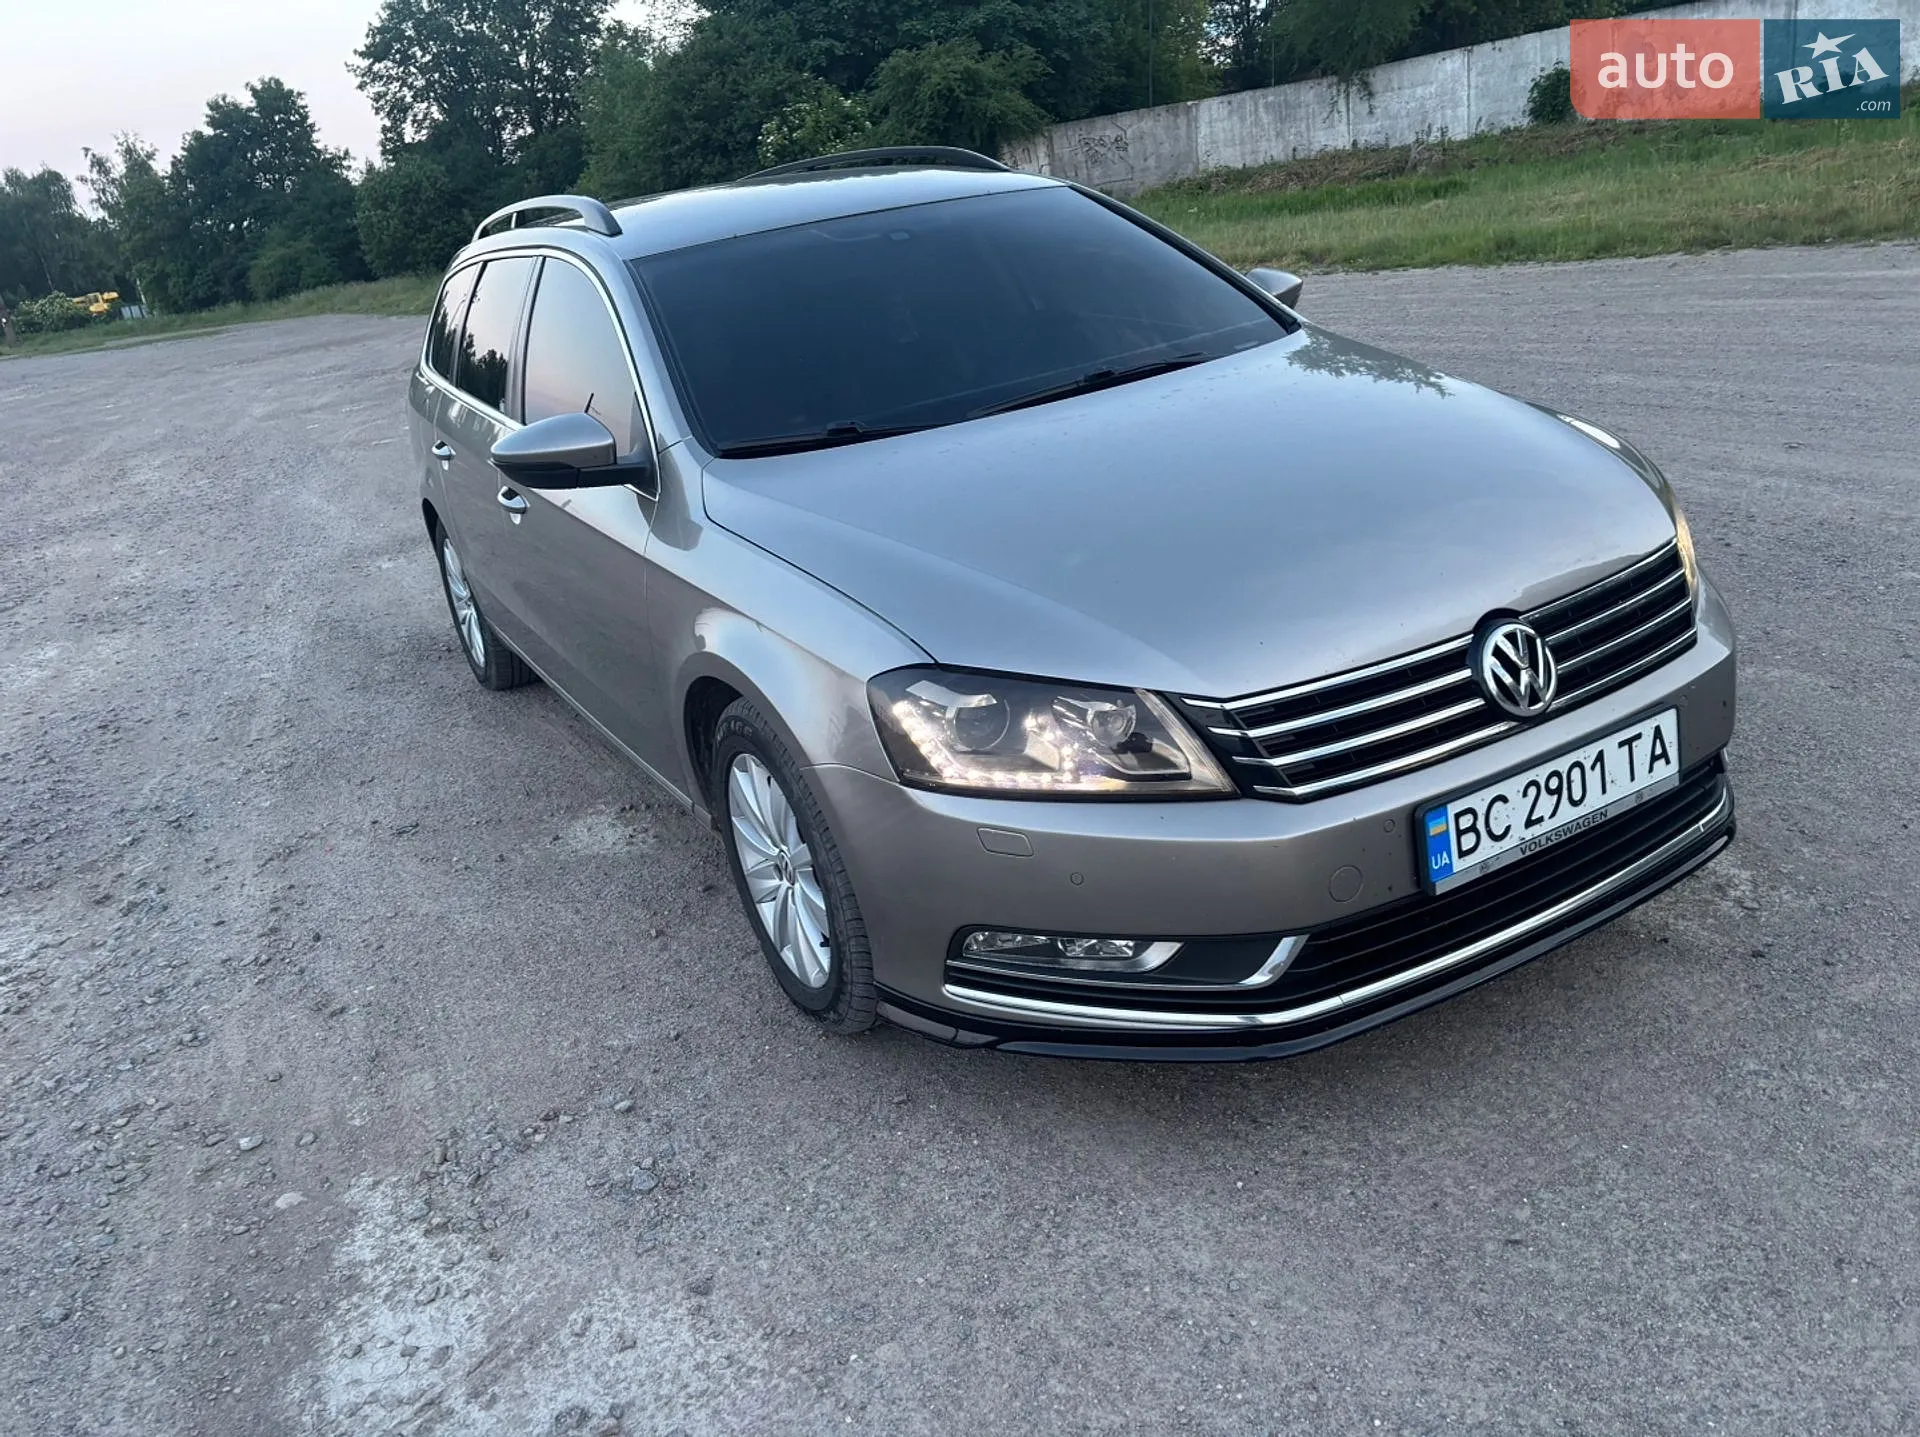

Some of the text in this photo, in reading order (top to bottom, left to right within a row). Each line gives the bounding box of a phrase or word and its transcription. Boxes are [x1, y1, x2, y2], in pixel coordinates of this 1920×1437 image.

[1453, 724, 1671, 860] BC 2901 TA
[1519, 808, 1608, 856] VOLKSWAGEN
[1431, 851, 1450, 870] UA
